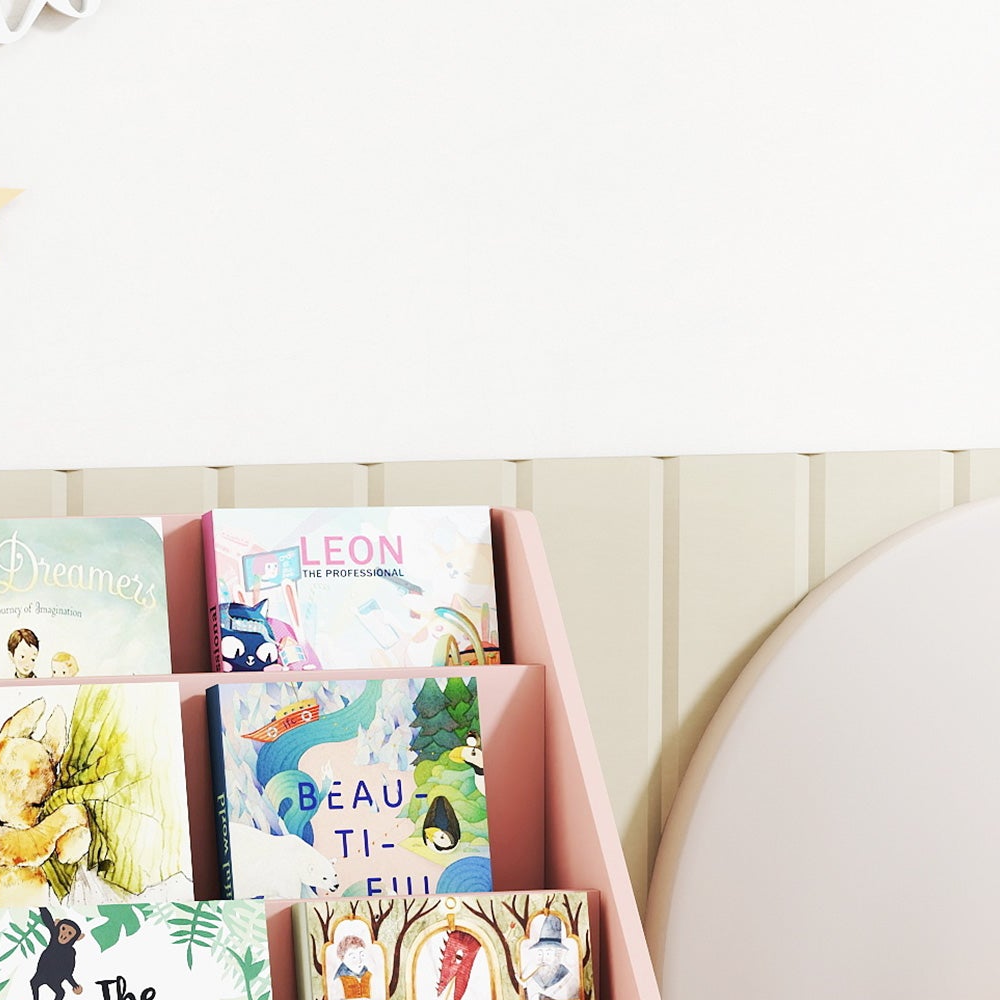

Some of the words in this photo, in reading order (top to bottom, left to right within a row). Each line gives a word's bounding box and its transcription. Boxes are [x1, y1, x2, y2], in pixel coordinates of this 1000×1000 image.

[300, 535, 404, 566] LEON
[303, 569, 322, 578] THE
[326, 568, 404, 578] PROFESSIONAL
[24, 602, 33, 613] of
[35, 601, 82, 618] Imagination
